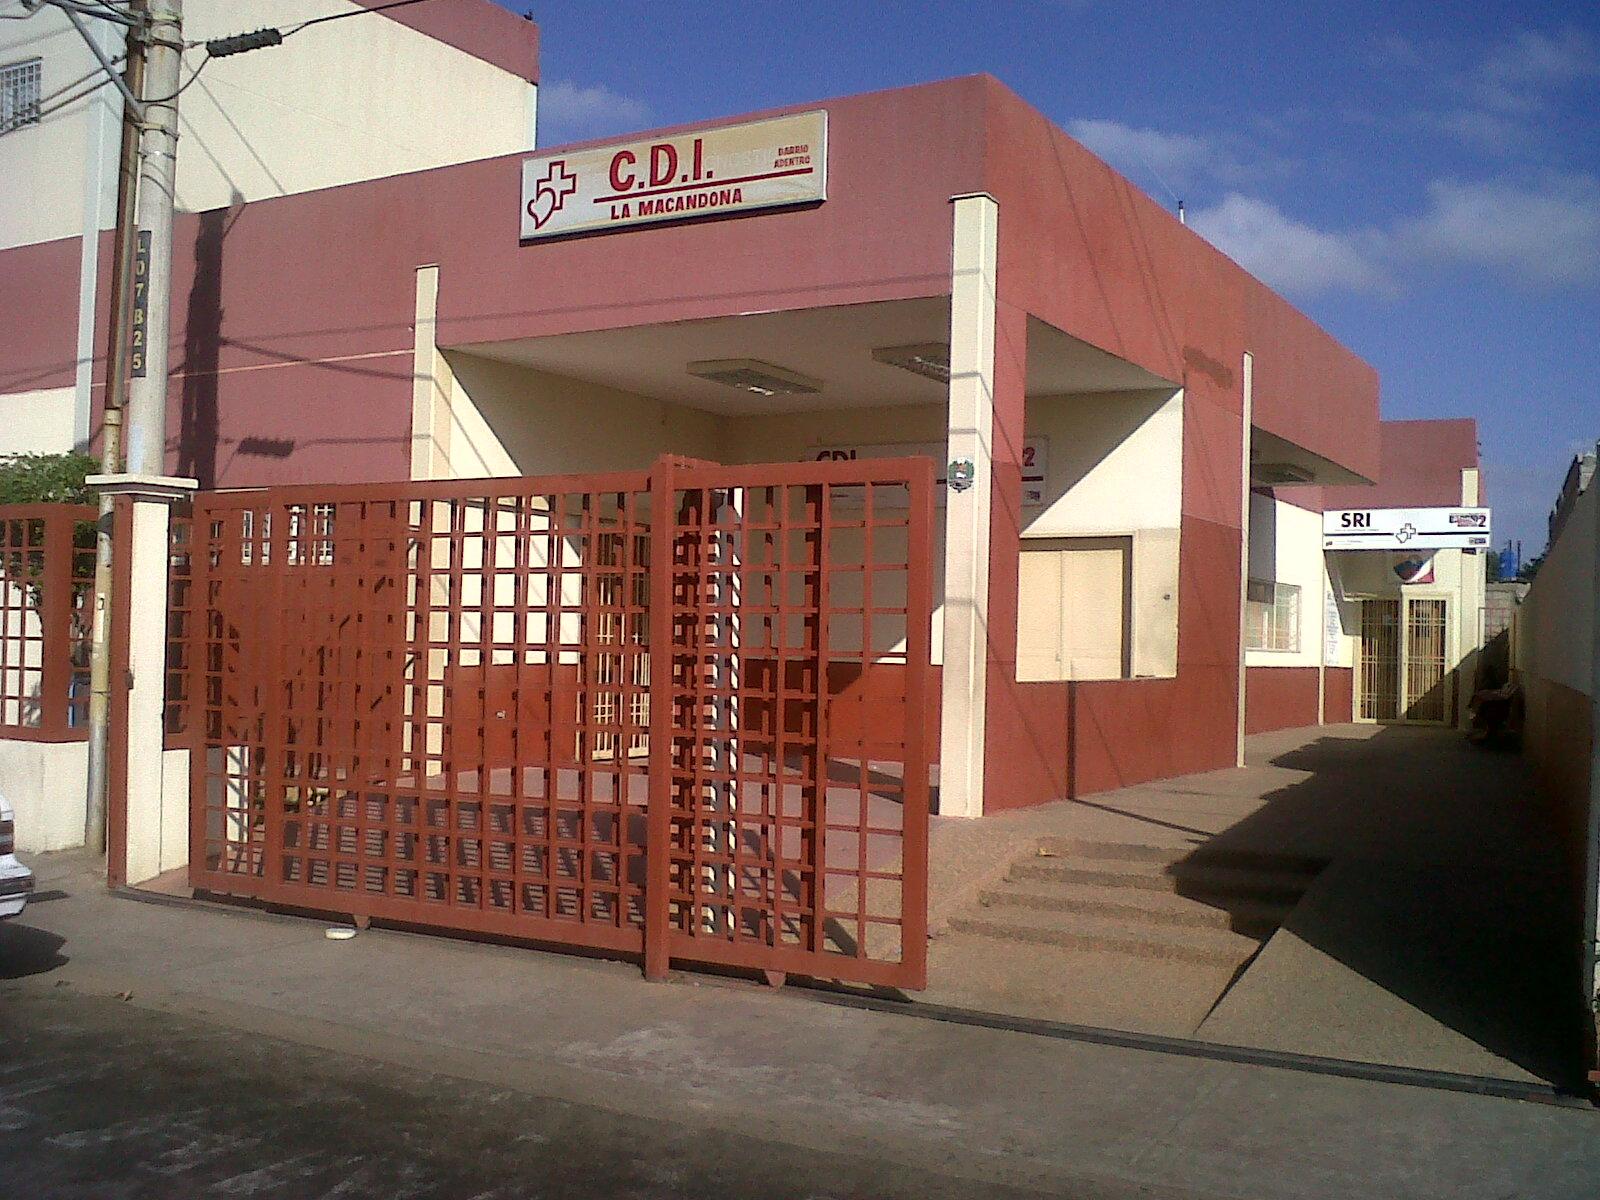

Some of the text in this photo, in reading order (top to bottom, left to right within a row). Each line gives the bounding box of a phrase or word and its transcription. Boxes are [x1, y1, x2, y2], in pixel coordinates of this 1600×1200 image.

[609, 138, 714, 192] C.D.I.
[610, 188, 743, 220] LA MACANDONA
[1341, 512, 1371, 528] SRI
